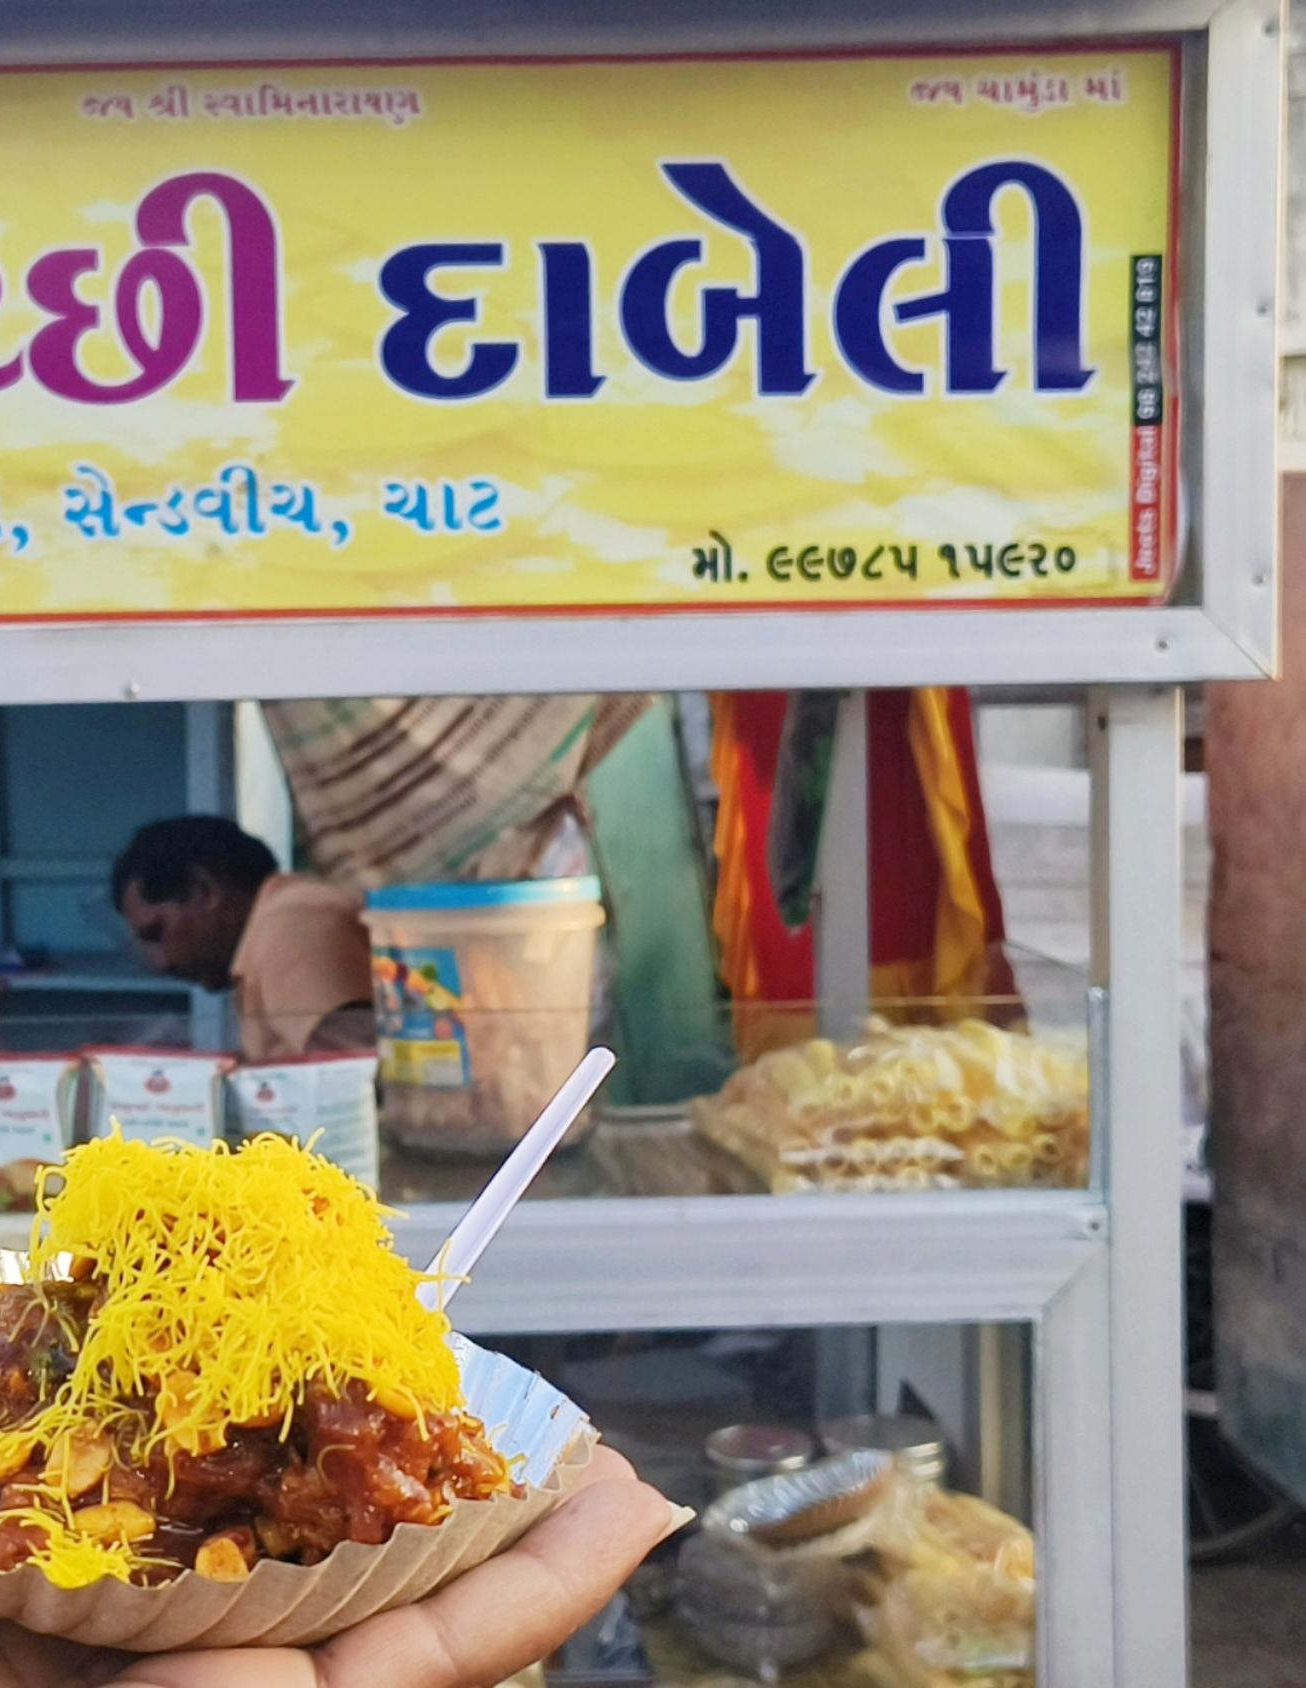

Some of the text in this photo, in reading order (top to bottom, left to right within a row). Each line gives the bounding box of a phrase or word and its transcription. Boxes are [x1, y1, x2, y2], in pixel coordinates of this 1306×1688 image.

[82, 84, 421, 125] જય શ્રી સ્વામિનારાયણ
[911, 68, 1121, 113] જય ચામુંડા માં
[378, 160, 1097, 399] દાબેલી
[64, 465, 350, 546] સેન્ડવીચ,
[384, 480, 503, 531] ચાટ
[692, 529, 1077, 582] મો. ૯૯૭૮૫ ૧૫૯૨૦
